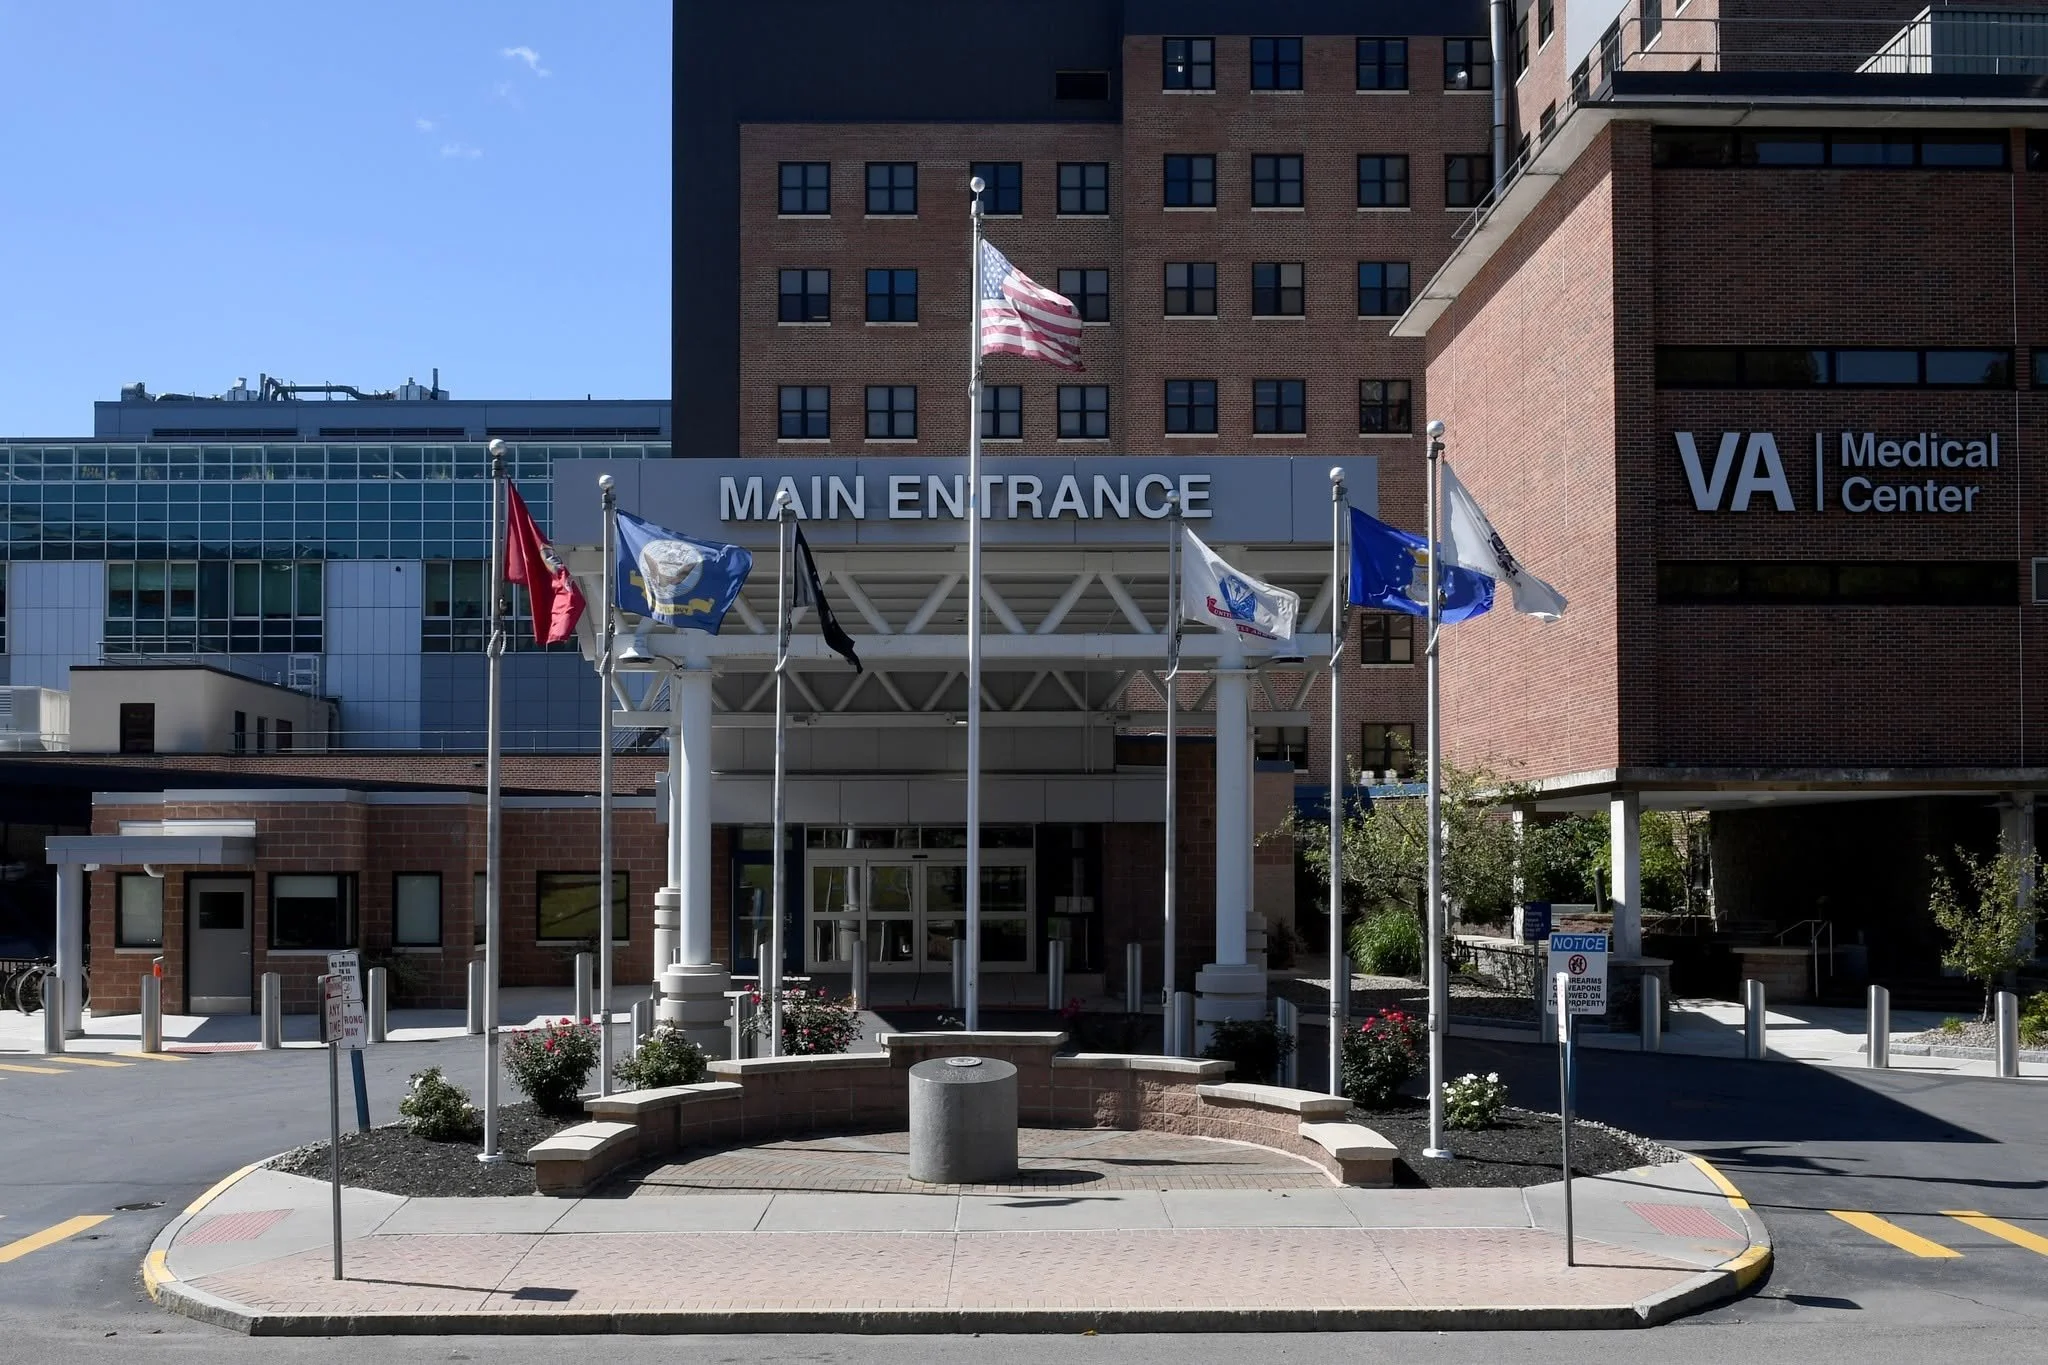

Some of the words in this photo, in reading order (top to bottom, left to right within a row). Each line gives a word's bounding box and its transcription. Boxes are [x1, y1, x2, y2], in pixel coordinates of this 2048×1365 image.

[1841, 432, 1999, 467] Medical
[1674, 431, 1796, 511] VA
[719, 475, 865, 521] MAIN
[888, 474, 1213, 519] ENTRANCE
[1841, 476, 1980, 512] Center
[1552, 937, 1604, 950] NOTICE
[329, 1004, 340, 1016] ANY
[329, 1020, 341, 1034] TIME
[345, 1028, 358, 1036] WAY
